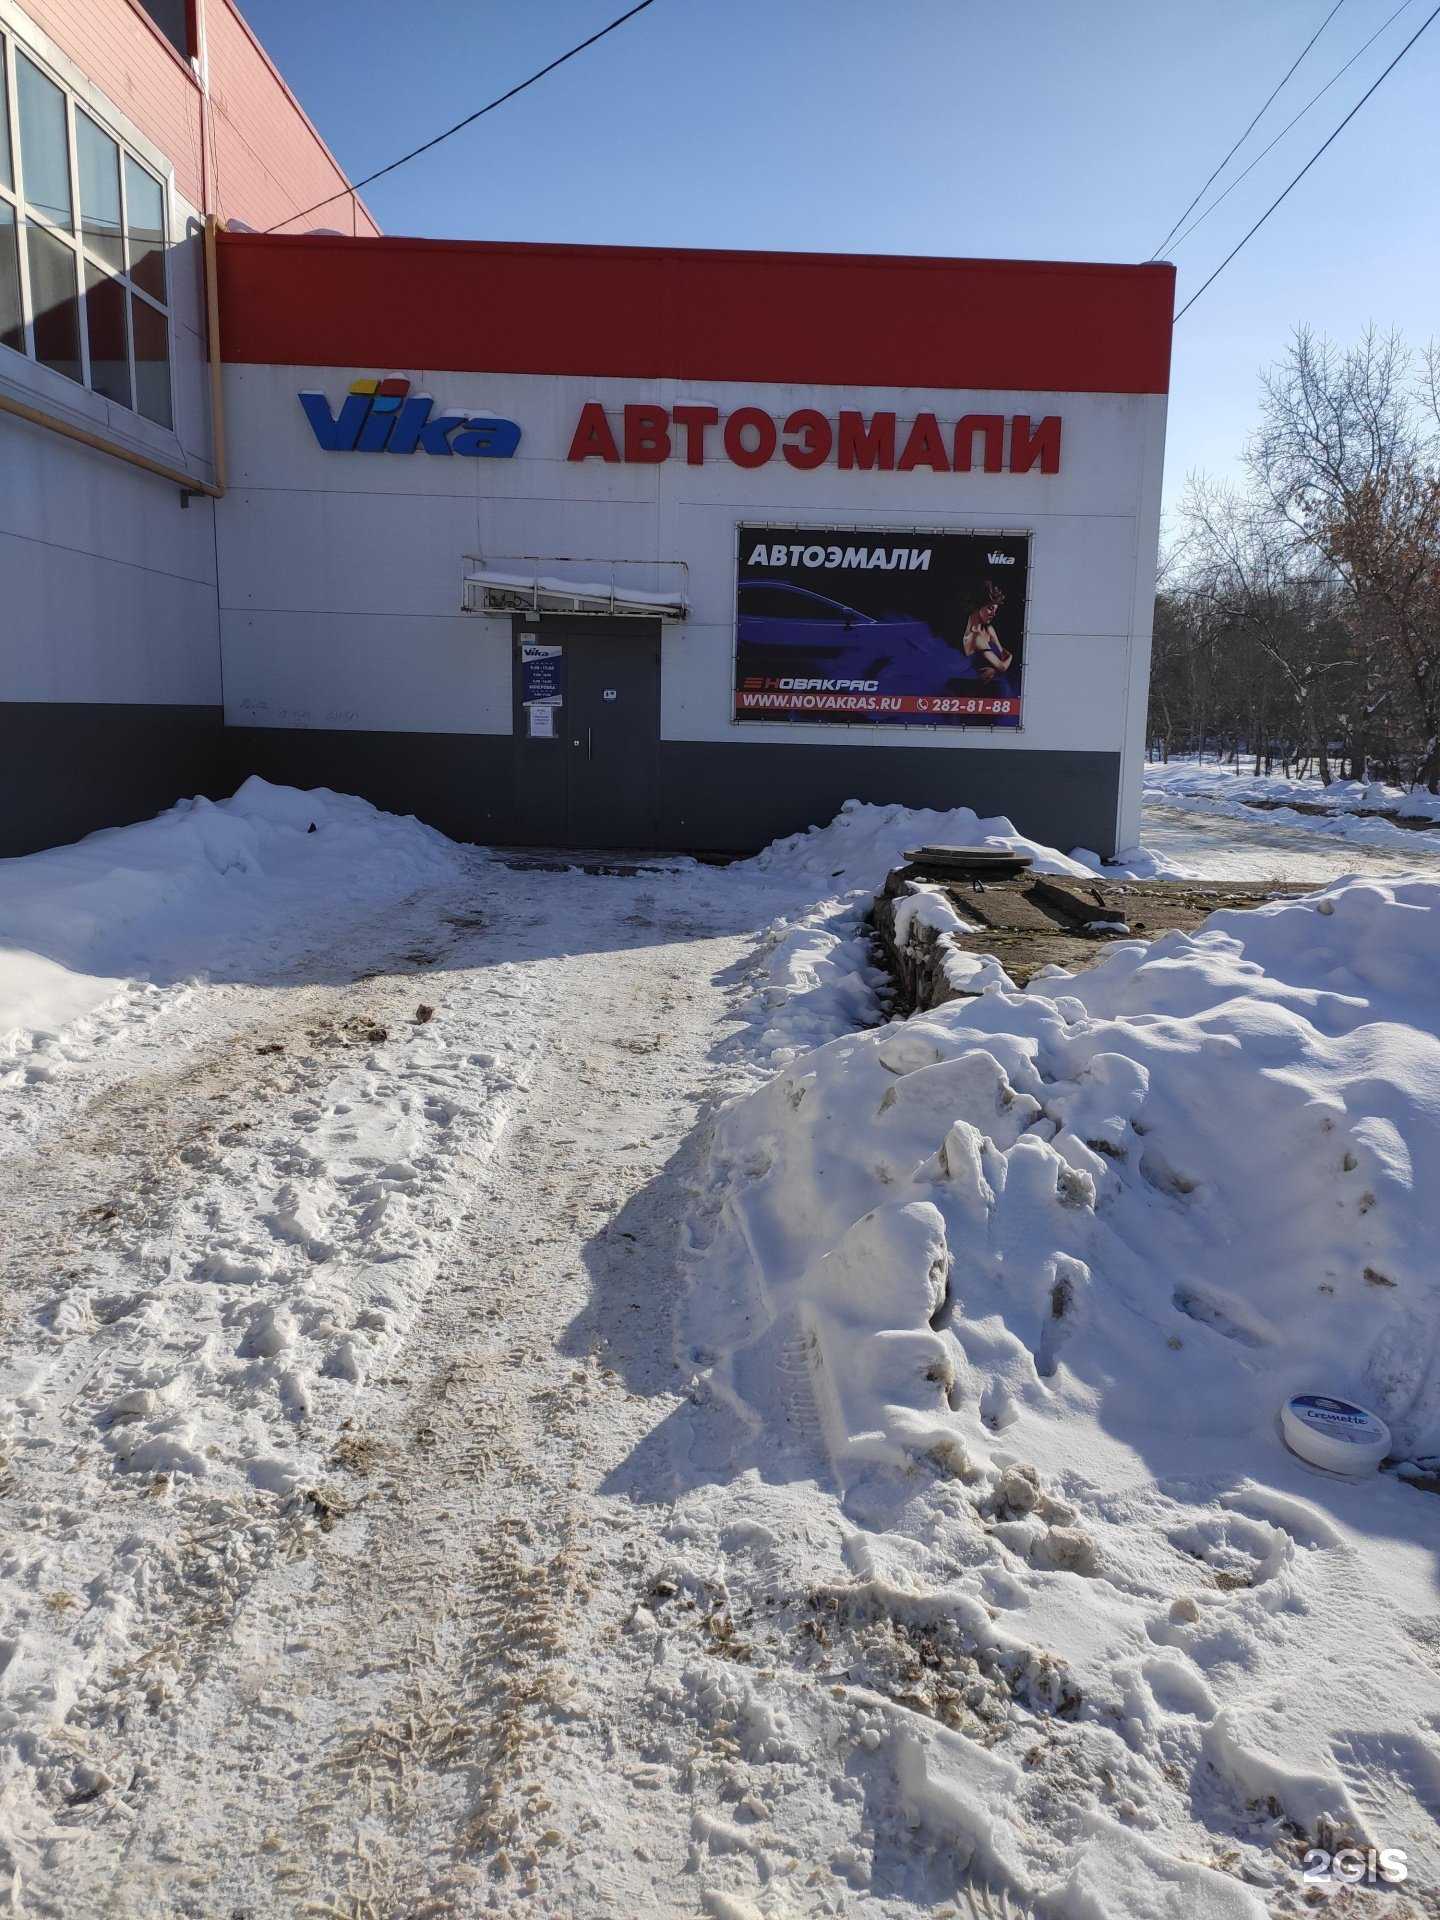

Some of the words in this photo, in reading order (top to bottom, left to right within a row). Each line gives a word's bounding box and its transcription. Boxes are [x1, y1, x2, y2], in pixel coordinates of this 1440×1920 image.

[297, 374, 522, 458] Vika
[567, 402, 1062, 474] АВТОЭМАЛИ
[747, 544, 931, 570] АВТОЭМАЛИ
[987, 551, 1015, 565] Vika
[743, 694, 901, 711] WWW.NOVAKRAS.RU
[932, 698, 1011, 713] 282-81-88
